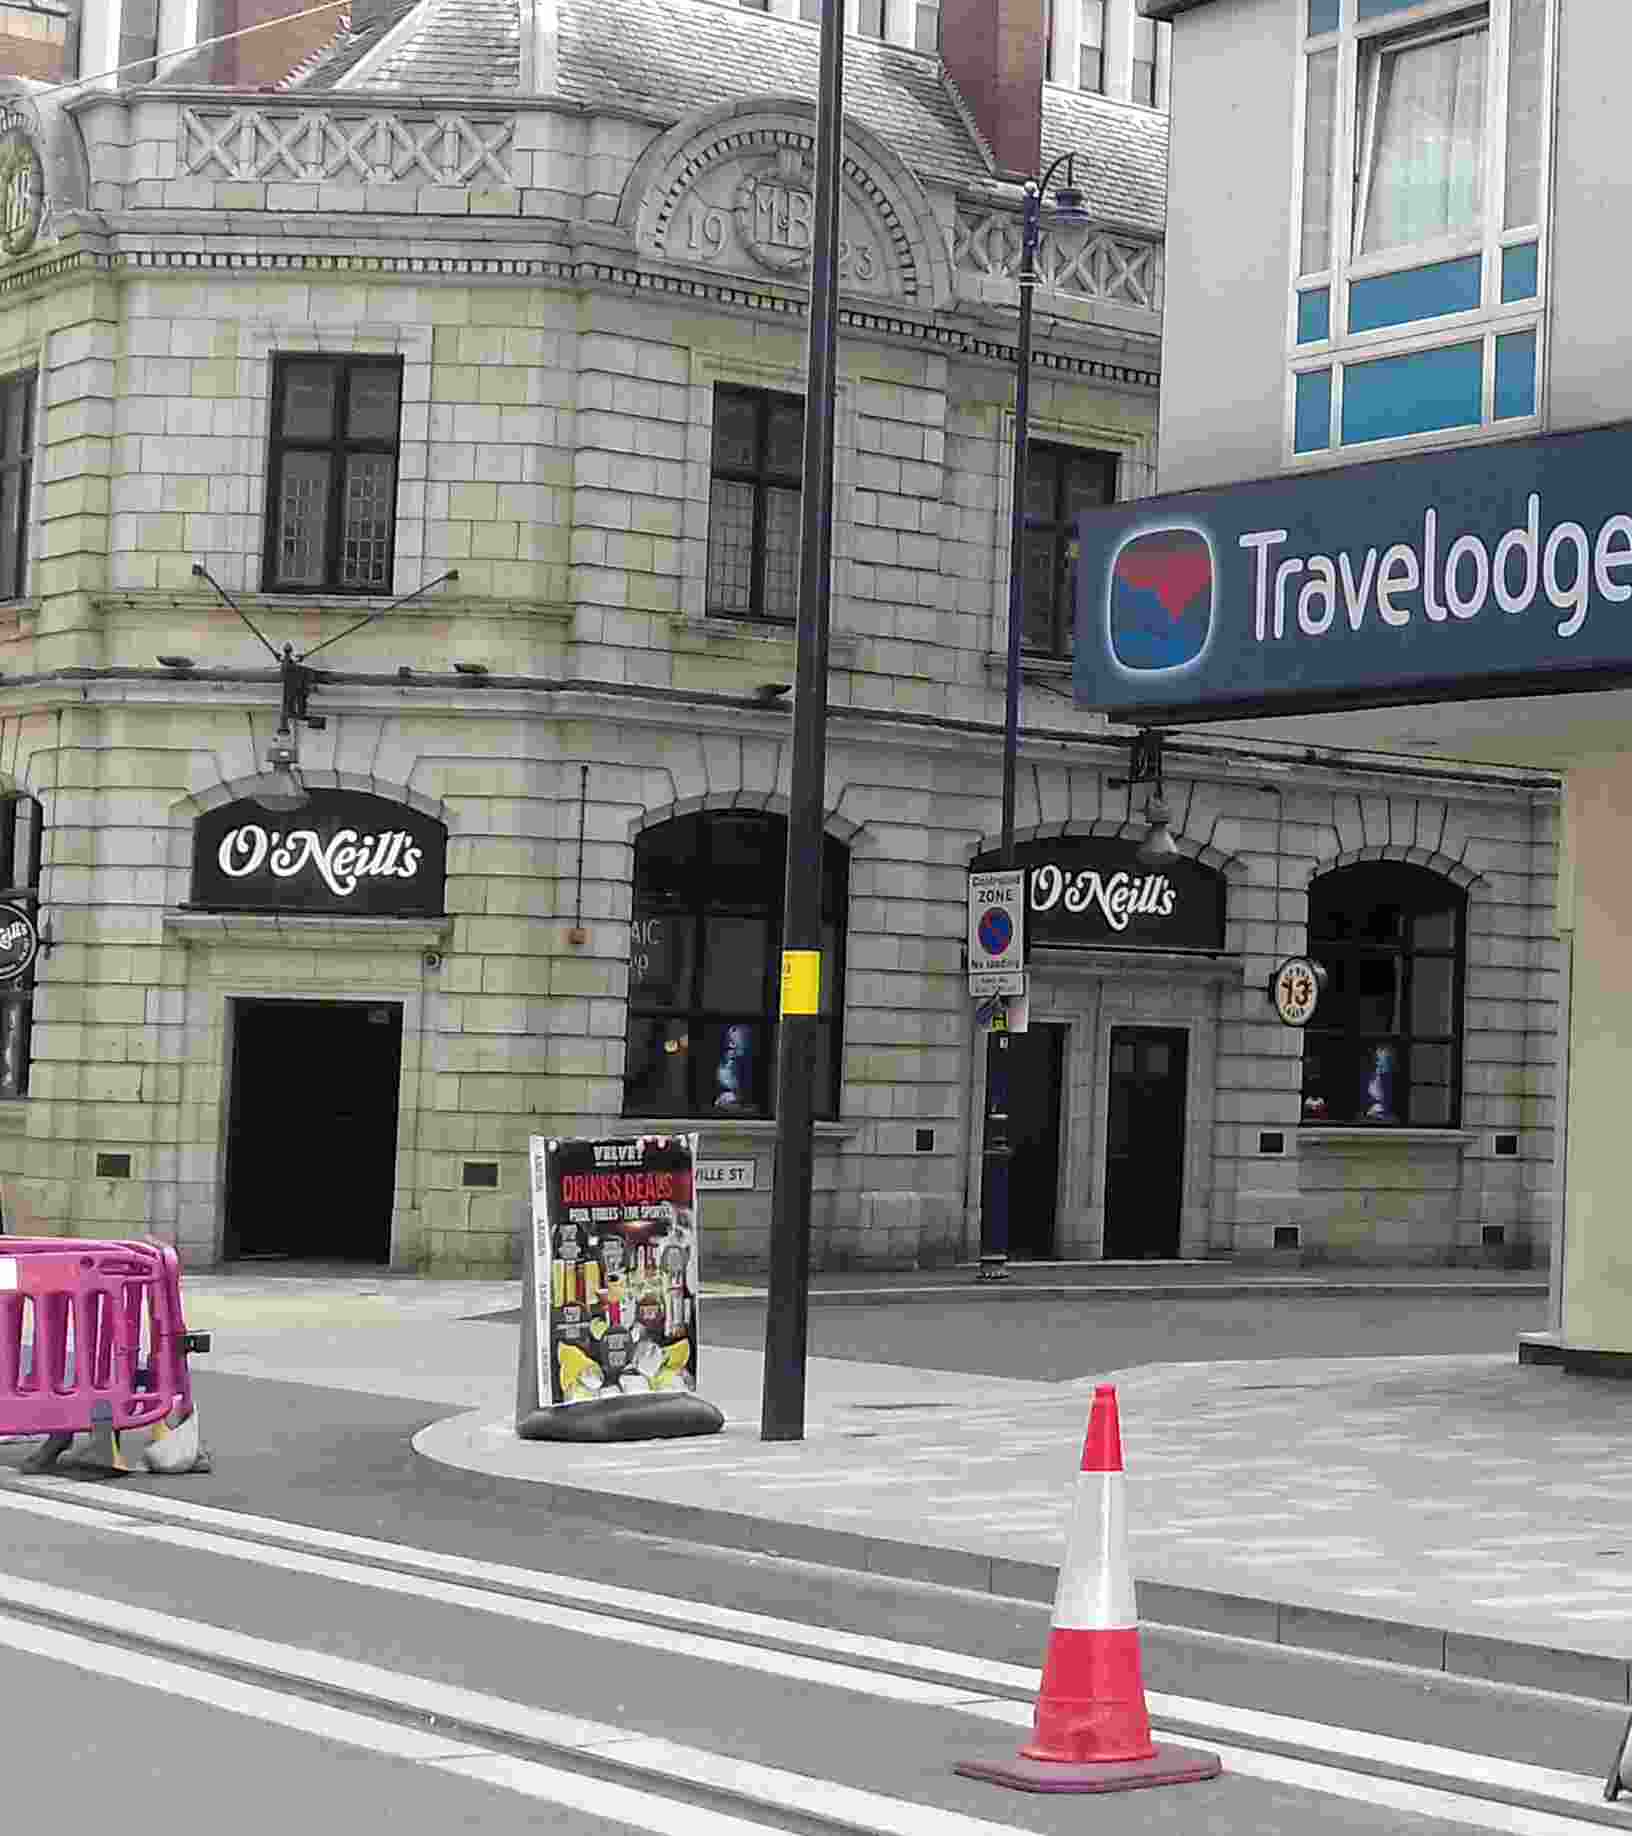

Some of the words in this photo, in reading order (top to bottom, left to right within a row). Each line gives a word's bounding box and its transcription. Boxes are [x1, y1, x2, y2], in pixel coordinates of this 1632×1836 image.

[219, 825, 422, 895] O'Neill's
[977, 889, 1017, 904] ZONE
[1030, 865, 1177, 931] O'Neill's
[562, 1175, 621, 1202] DRINKS
[623, 1173, 673, 1201] DEALS
